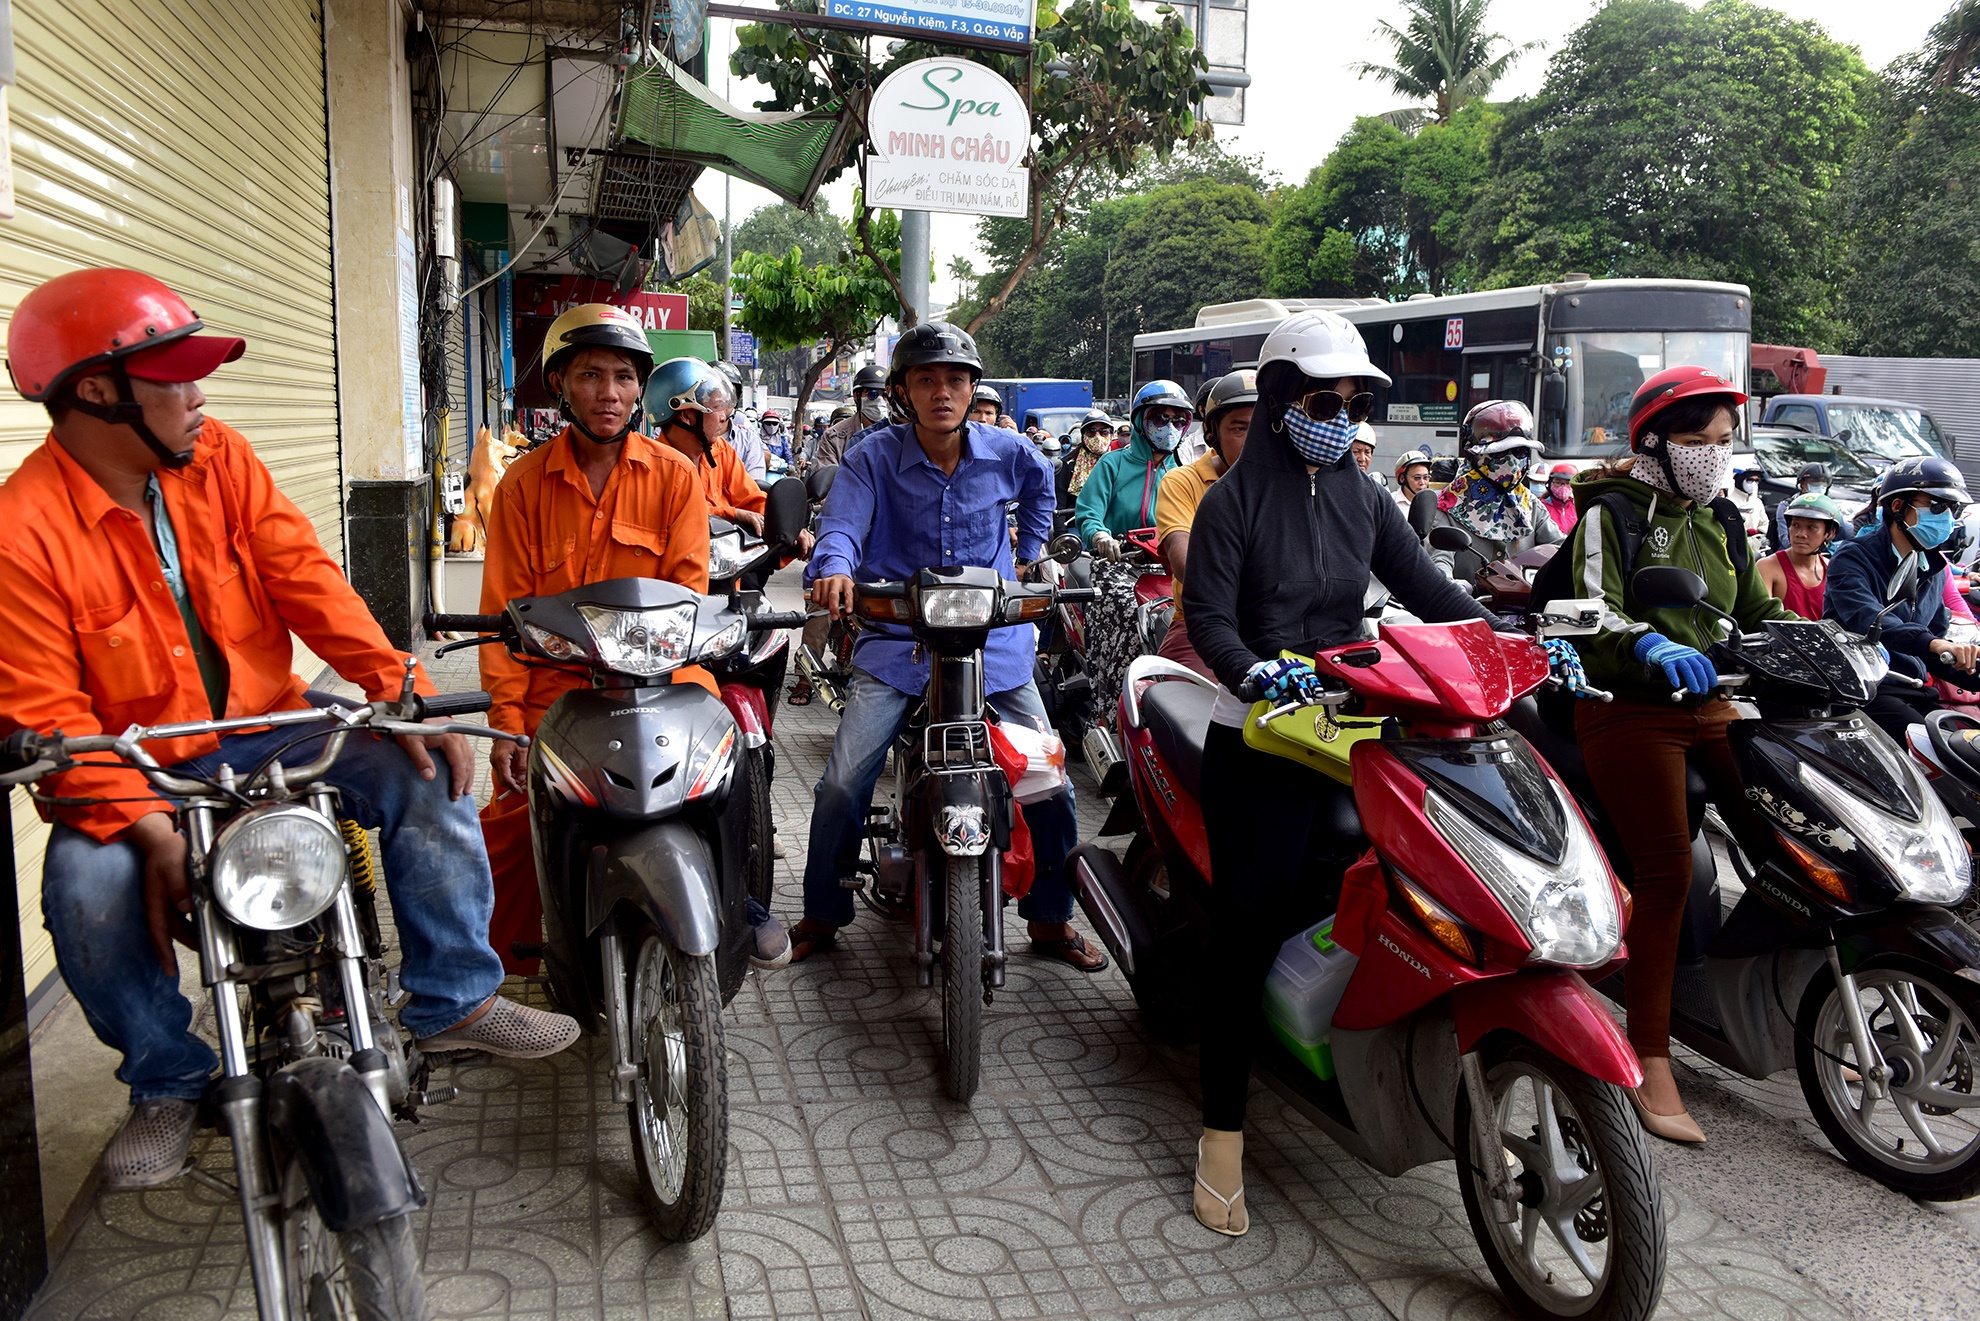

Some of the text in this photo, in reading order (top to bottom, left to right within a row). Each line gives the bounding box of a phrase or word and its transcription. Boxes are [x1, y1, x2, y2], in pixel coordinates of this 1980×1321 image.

[834, 3, 1025, 41] ĐC: 27 Nguyễn Kiệm, F.3, Q.Gò Vấp
[900, 66, 1002, 126] Spa
[889, 131, 1011, 164] MINH CHÂU
[938, 171, 1017, 189] CHĂM SÓC DA
[940, 190, 955, 206] TRỊ
[957, 192, 978, 207] MỤN
[629, 305, 671, 330] BAY
[1446, 320, 1462, 347] 55
[941, 656, 975, 664] HONDA
[609, 707, 661, 717] HONDA
[1760, 878, 1812, 918] HONDA
[1377, 933, 1432, 980] HONDA
